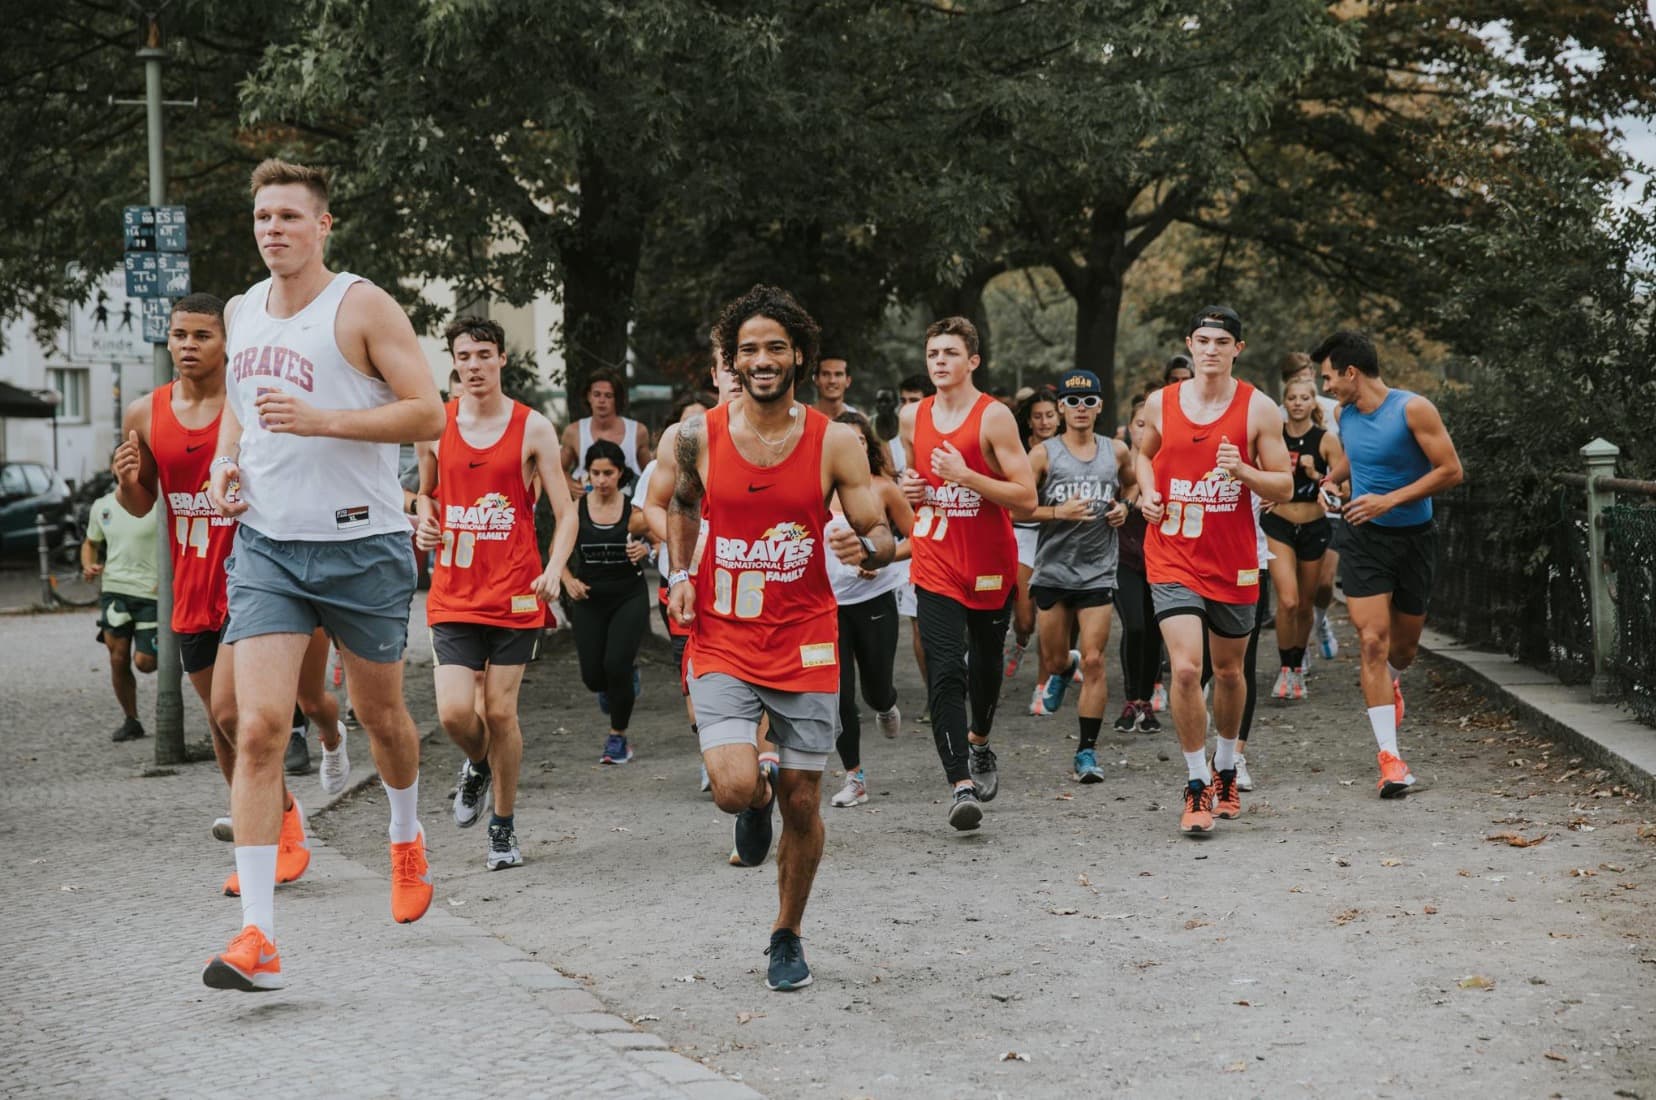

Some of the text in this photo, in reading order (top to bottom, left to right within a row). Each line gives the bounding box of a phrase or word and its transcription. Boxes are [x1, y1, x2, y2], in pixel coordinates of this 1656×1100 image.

[924, 485, 982, 503] RAVES
[1054, 481, 1114, 503] SUGAR
[1169, 477, 1243, 498] BRAVES
[947, 509, 979, 517] FAMILY
[1205, 503, 1238, 513] FAMILY
[1160, 501, 1205, 539] 38
[477, 532, 510, 541] FAMILY
[715, 536, 815, 563] BRAVES
[715, 557, 809, 571] INTERNATIONAL SPORTS
[765, 567, 806, 583] FAMILY
